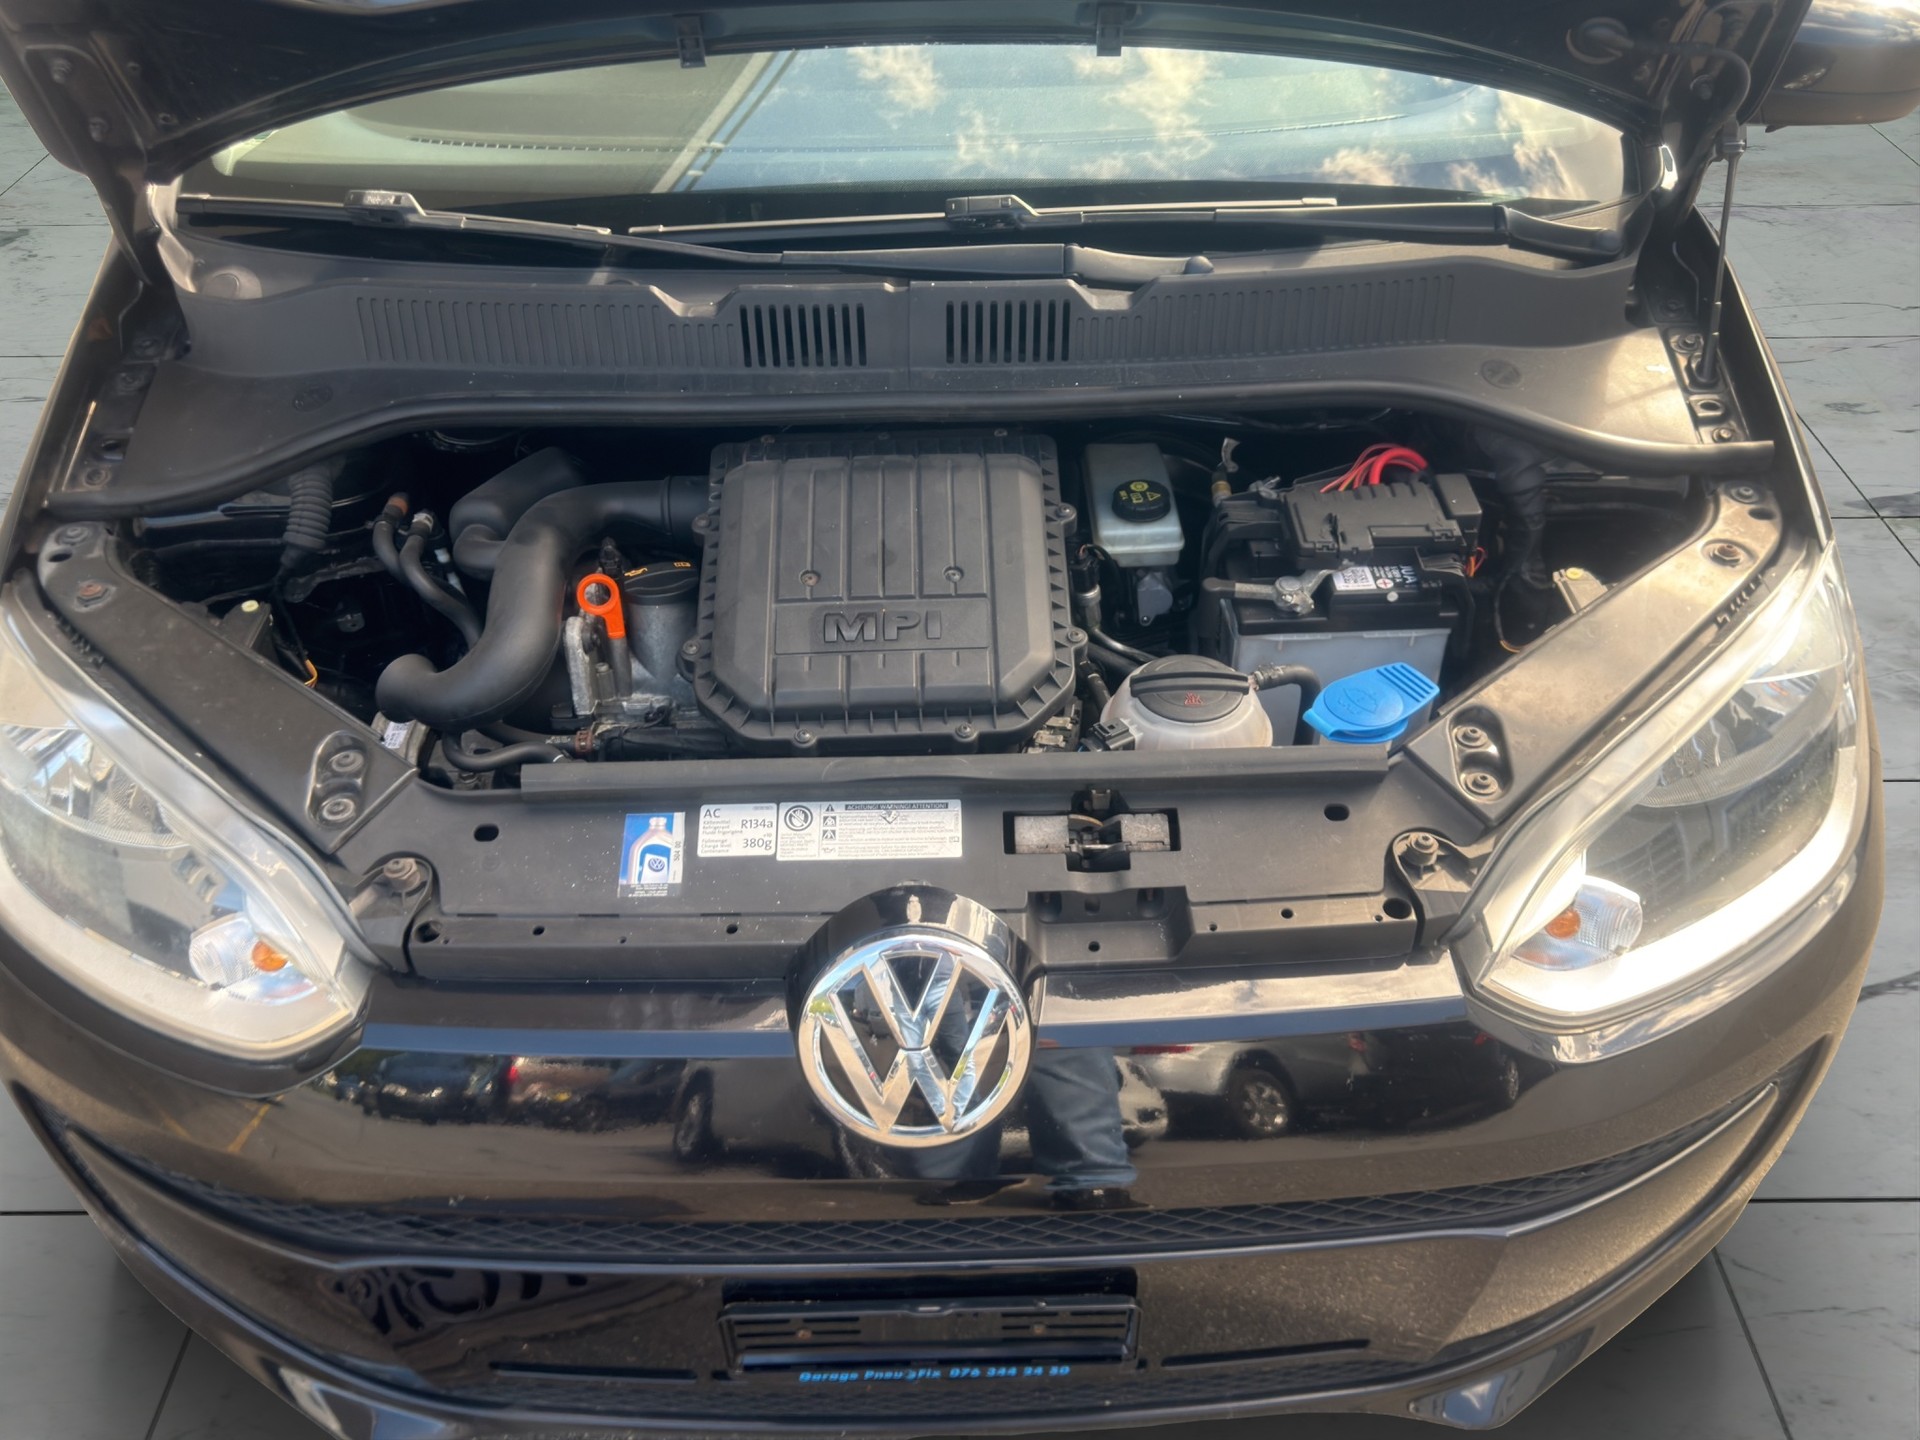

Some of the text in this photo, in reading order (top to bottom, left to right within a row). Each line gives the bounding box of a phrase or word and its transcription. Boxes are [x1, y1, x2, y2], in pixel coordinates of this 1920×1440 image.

[824, 610, 942, 642] MPI
[704, 808, 720, 818] AC
[741, 819, 773, 829] R134a
[743, 838, 772, 851] 380g
[802, 934, 1028, 1144] VW
[949, 1367, 981, 1378] 076
